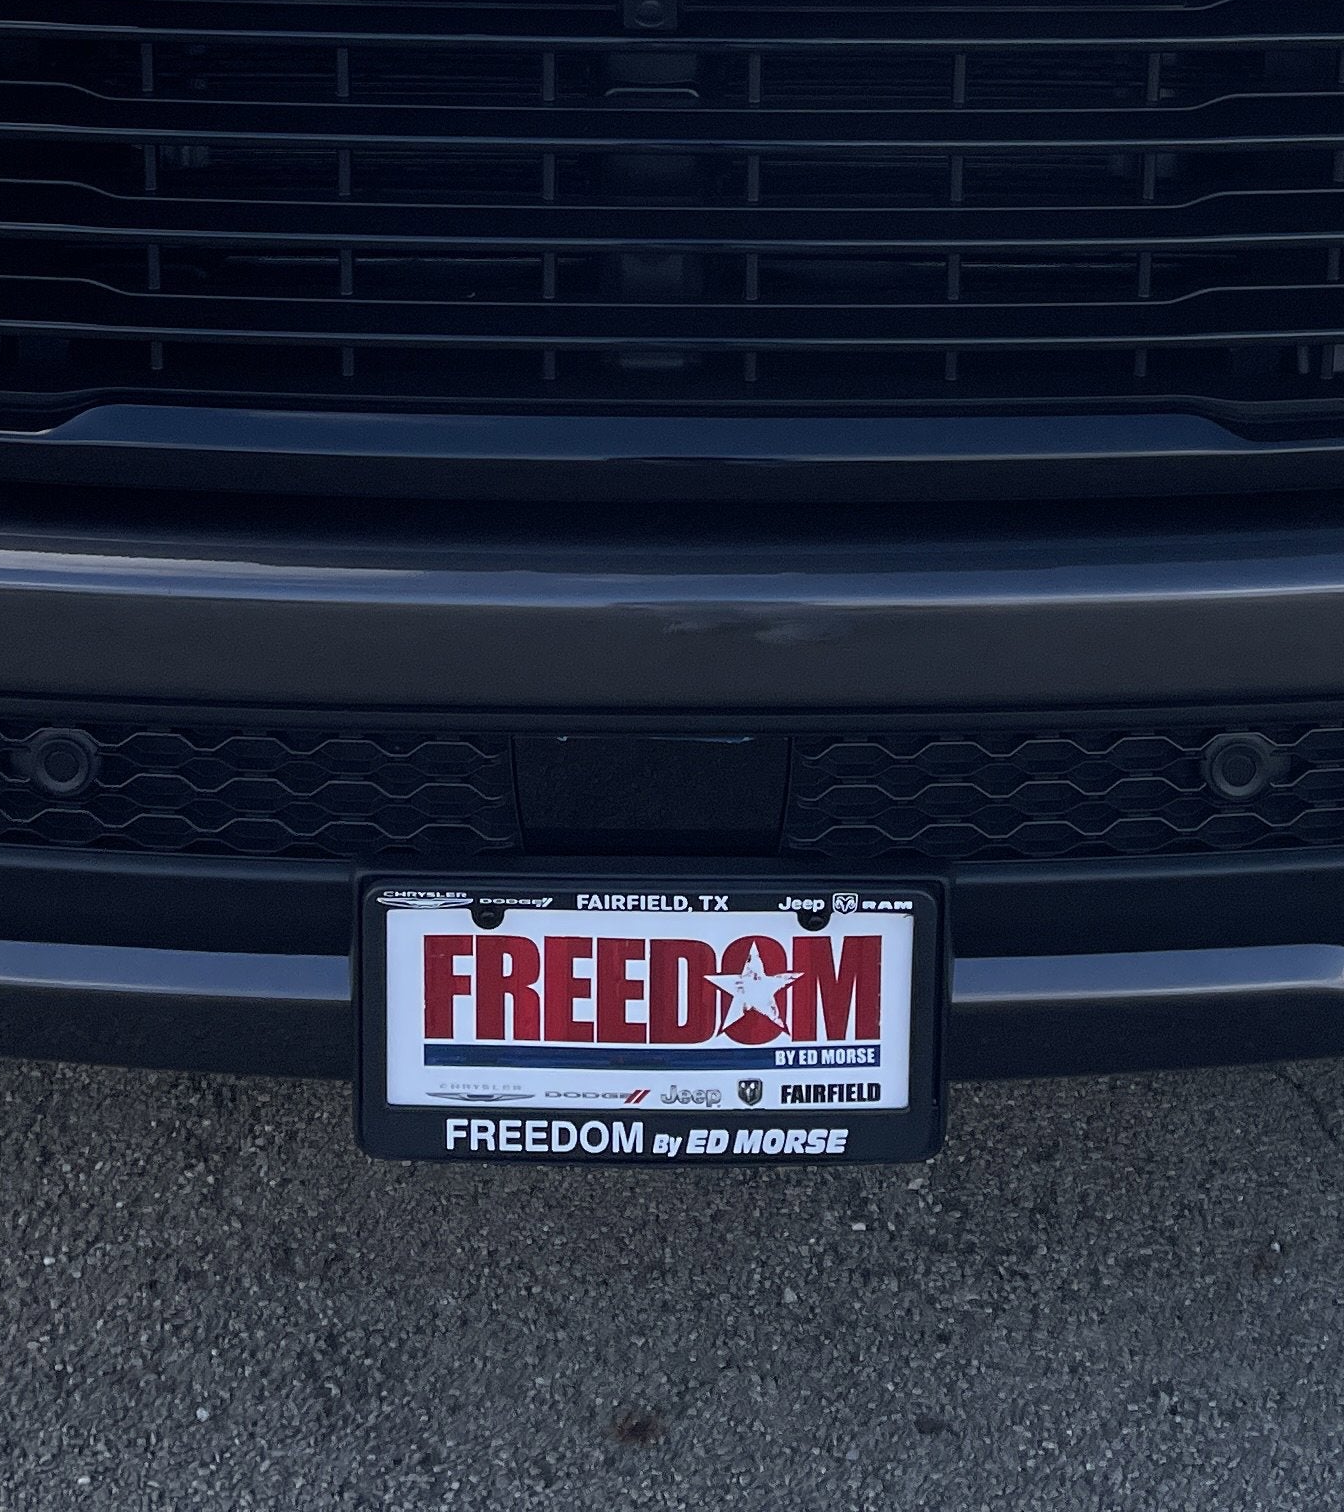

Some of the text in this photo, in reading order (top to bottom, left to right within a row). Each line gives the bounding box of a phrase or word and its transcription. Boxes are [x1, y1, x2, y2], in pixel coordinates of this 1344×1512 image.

[383, 890, 467, 899] CHRYSLER
[576, 894, 729, 913] FAIRFIELD, TX
[777, 896, 826, 913] Jeep
[861, 900, 913, 910] RAM
[423, 934, 883, 1045] FREEDOM
[775, 1047, 875, 1066] BY ED MORSE
[660, 1084, 722, 1108] Jeep
[780, 1082, 882, 1105] FAIRFIELD
[445, 1118, 850, 1158] FREEDOM By ED MORSE
